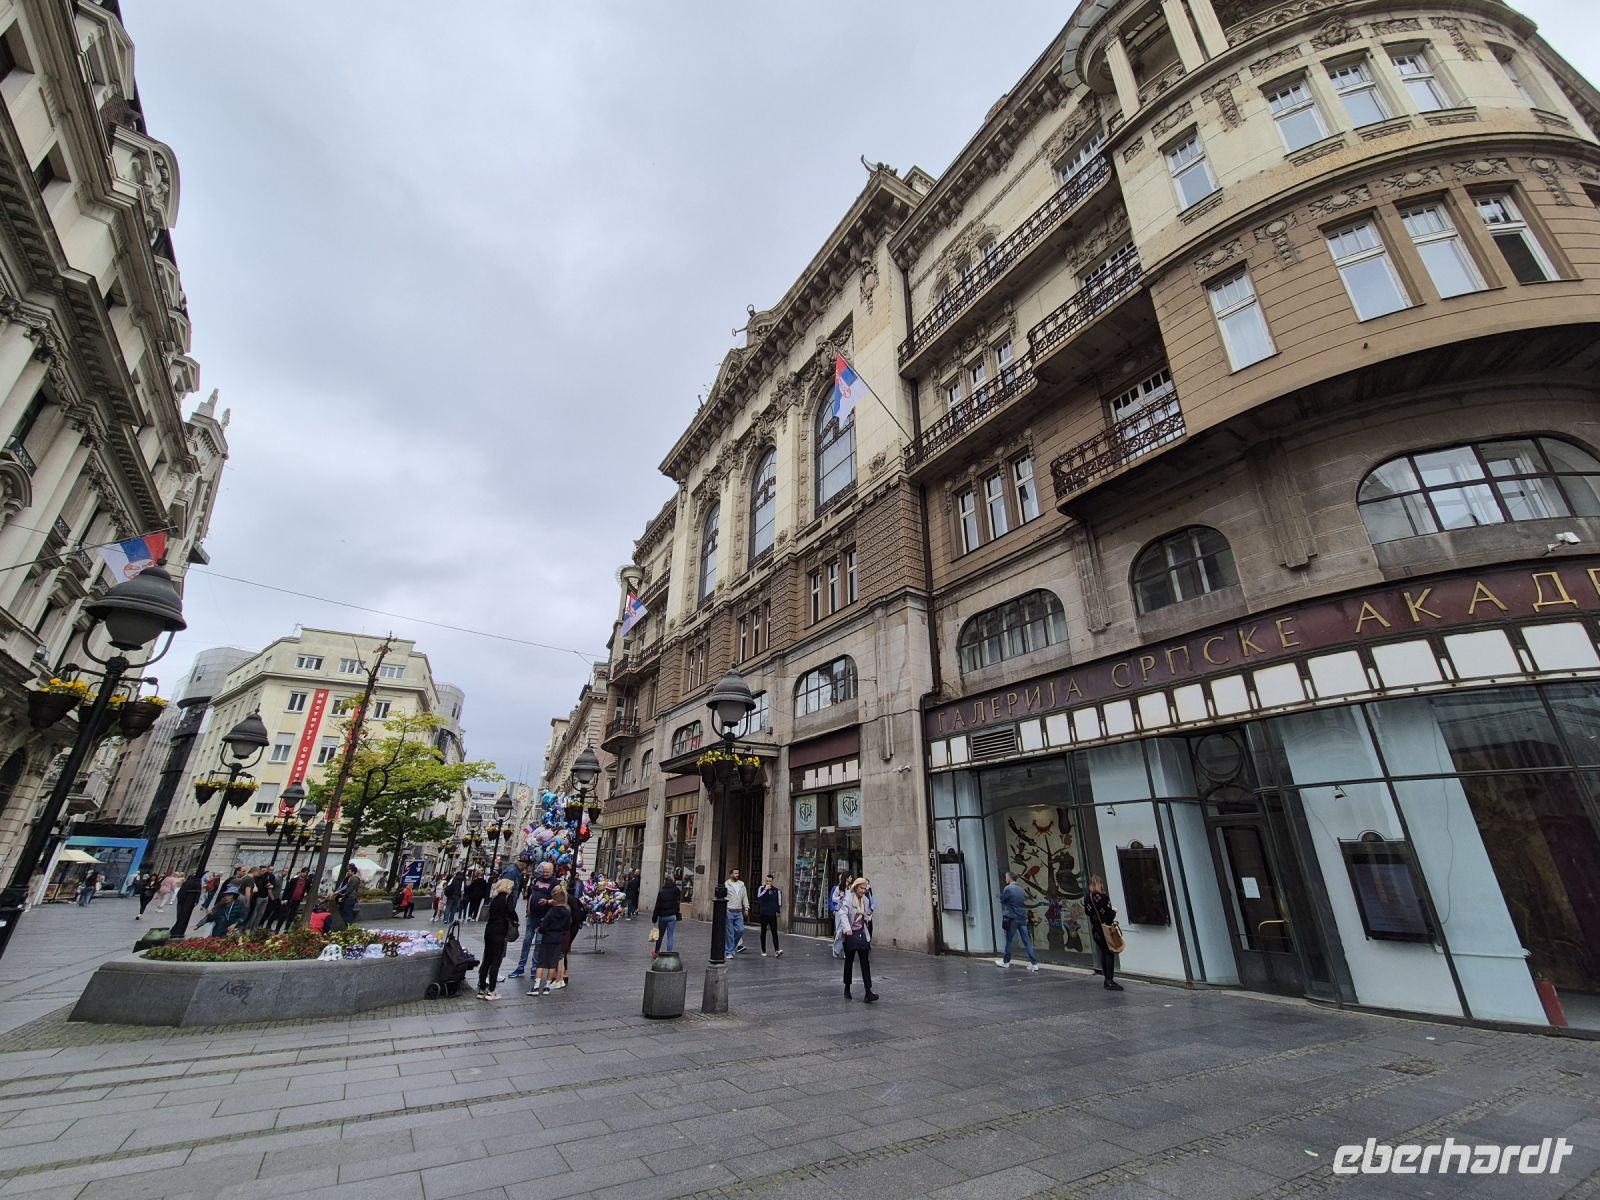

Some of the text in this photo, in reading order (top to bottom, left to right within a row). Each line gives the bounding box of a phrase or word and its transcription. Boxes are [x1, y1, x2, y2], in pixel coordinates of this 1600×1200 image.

[938, 677, 1084, 732] ГАЛЕРИЈА
[1111, 616, 1300, 688] СРПСКЕ
[306, 692, 325, 741] Институт
